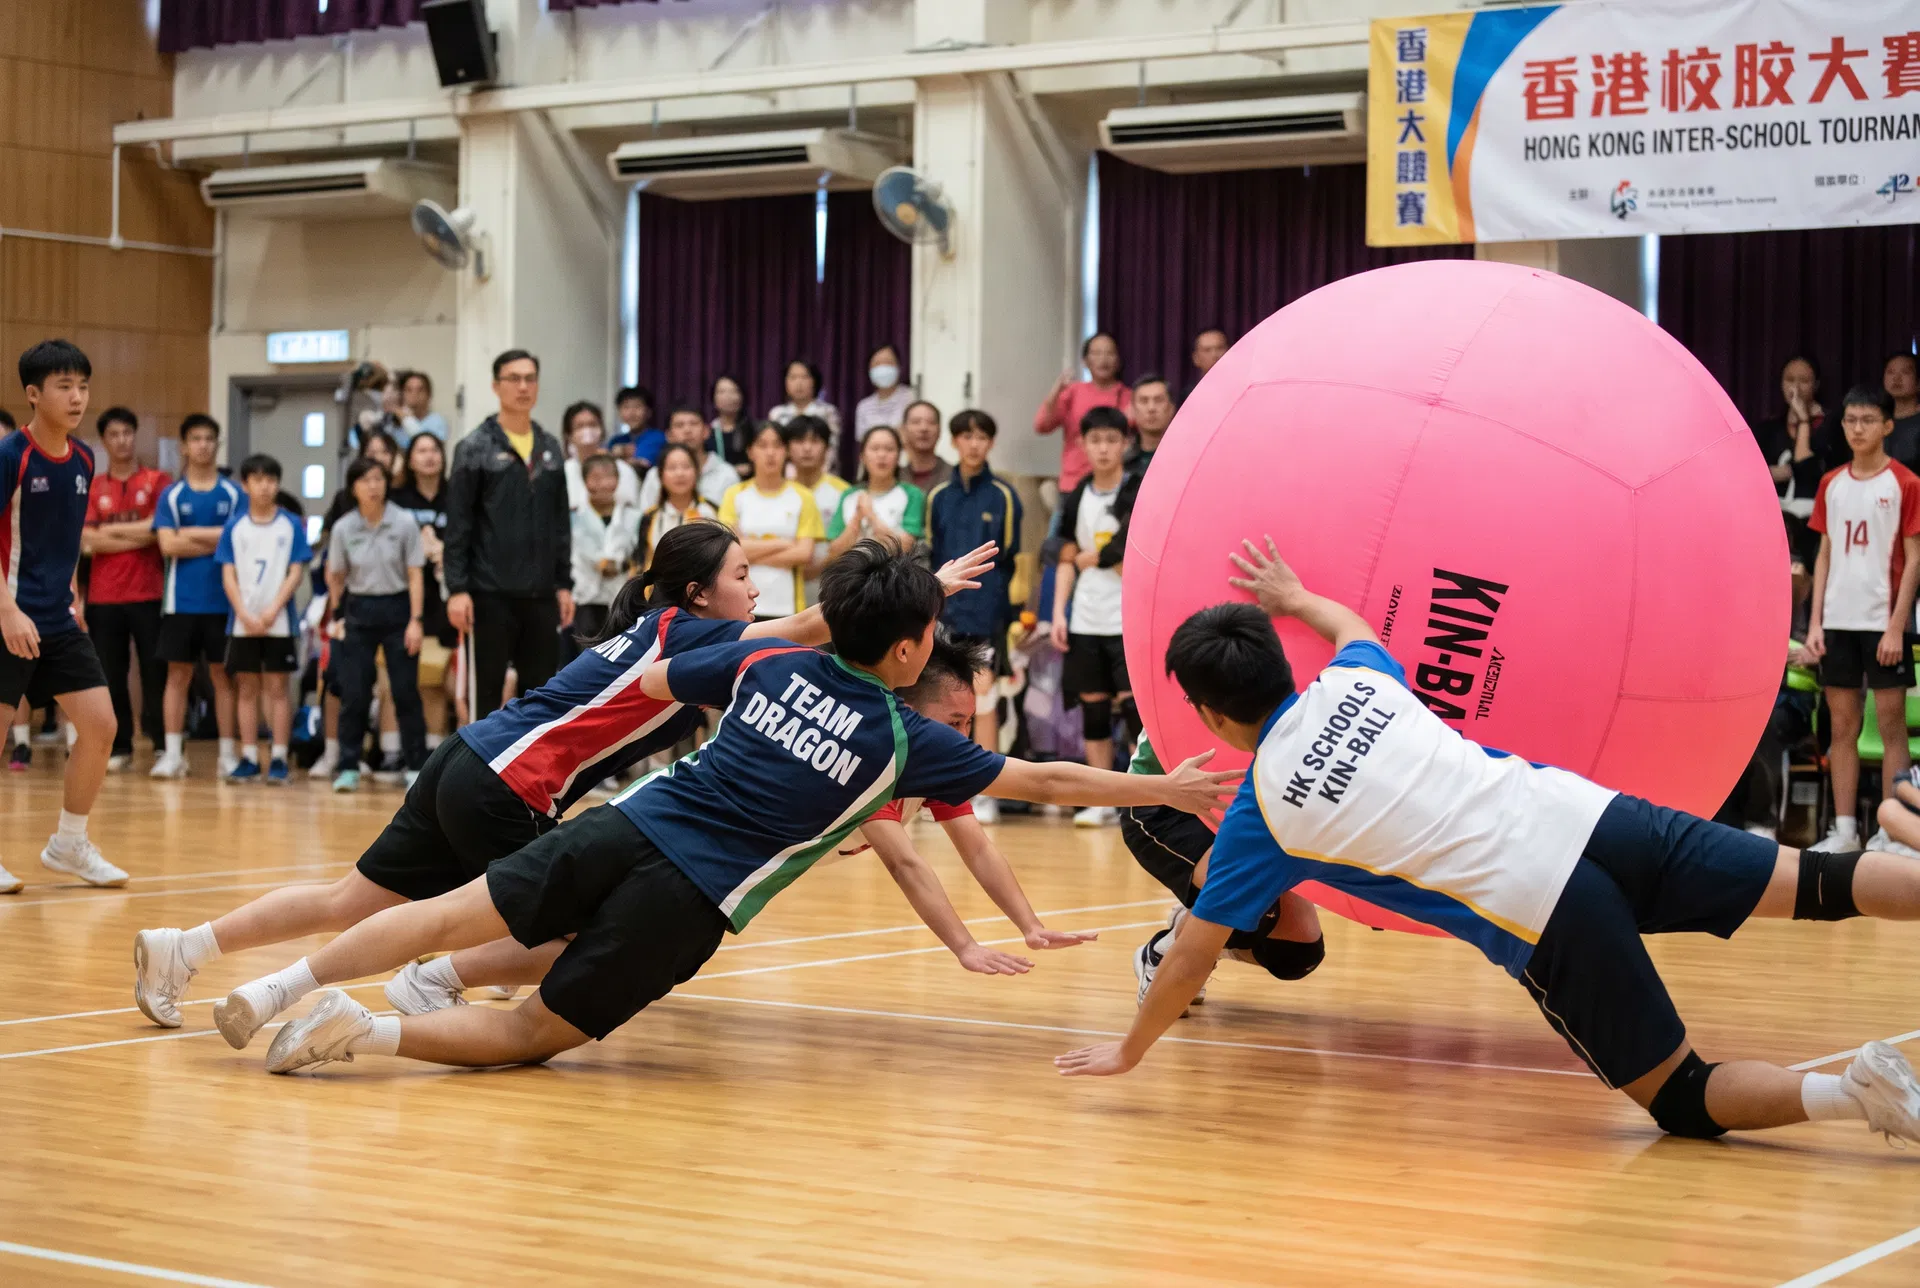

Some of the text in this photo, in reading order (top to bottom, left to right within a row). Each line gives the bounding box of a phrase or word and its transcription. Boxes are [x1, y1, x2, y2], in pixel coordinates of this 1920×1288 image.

[1523, 135, 1580, 161] HONG
[1588, 131, 1645, 157] KONG
[1652, 120, 1811, 155] INTER-SCHOOL
[254, 559, 267, 584] 7
[1844, 520, 1869, 556] 14
[1412, 567, 1510, 734] KIN-BA
[739, 691, 863, 787] DRAGON
[779, 672, 864, 741] TEAM
[1281, 681, 1376, 809] HK SCHOOLS
[1317, 707, 1396, 804] KIN-BALL
